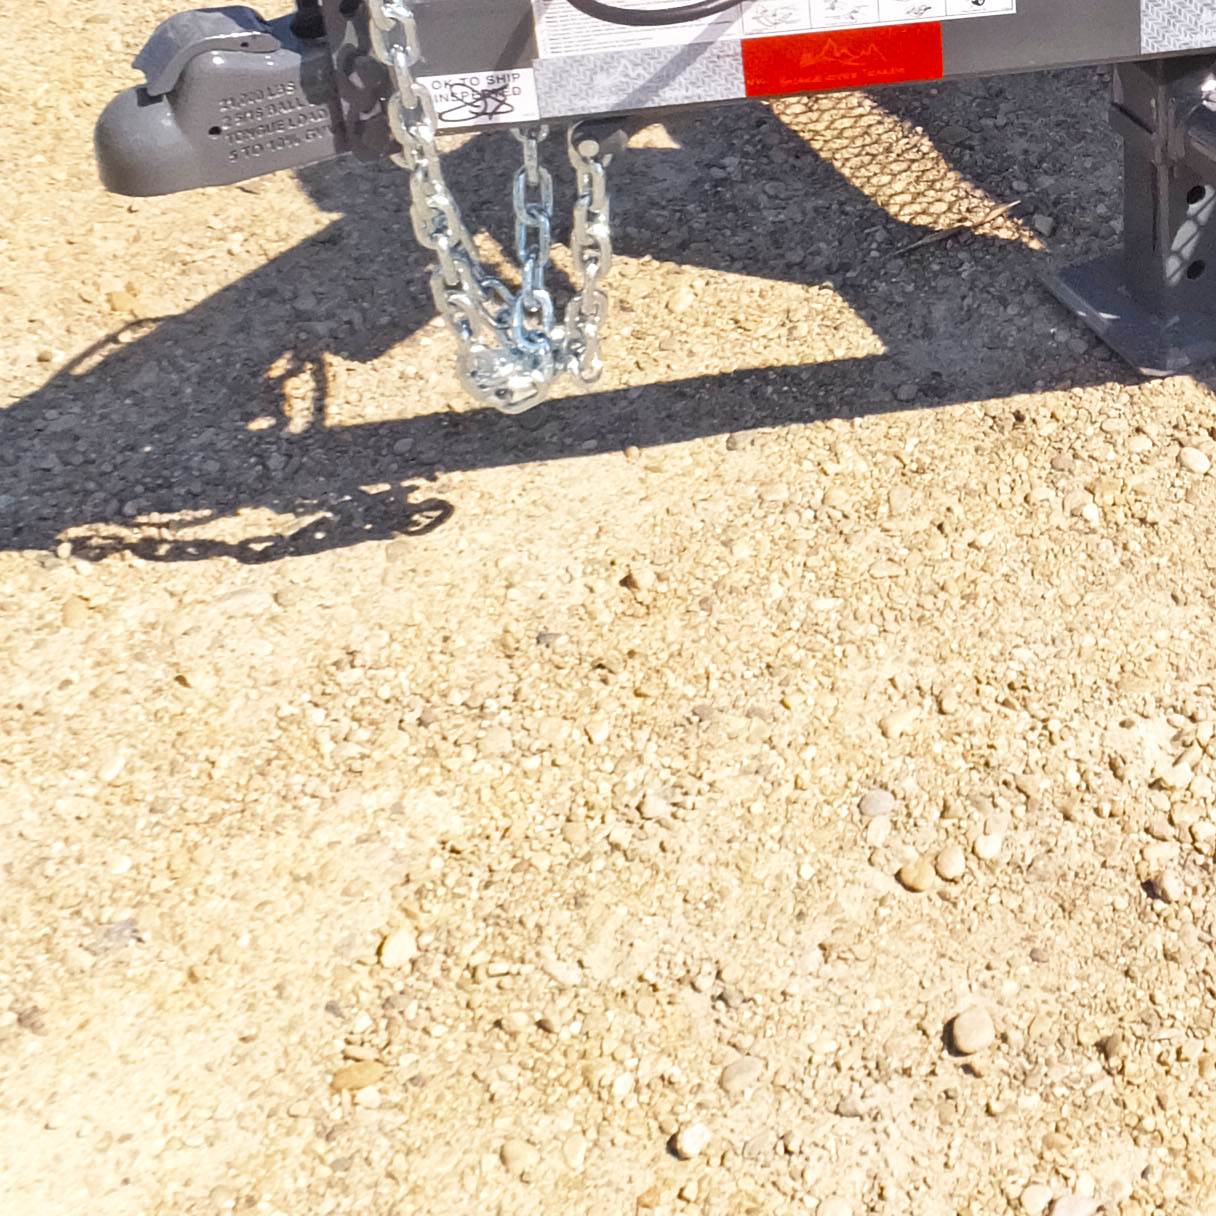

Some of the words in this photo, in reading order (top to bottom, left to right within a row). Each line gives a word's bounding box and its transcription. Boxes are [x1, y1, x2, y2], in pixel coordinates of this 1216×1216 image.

[431, 80, 453, 90] OK
[460, 77, 480, 86] TO
[486, 72, 521, 86] SHIP
[434, 86, 522, 103] INSPEED
